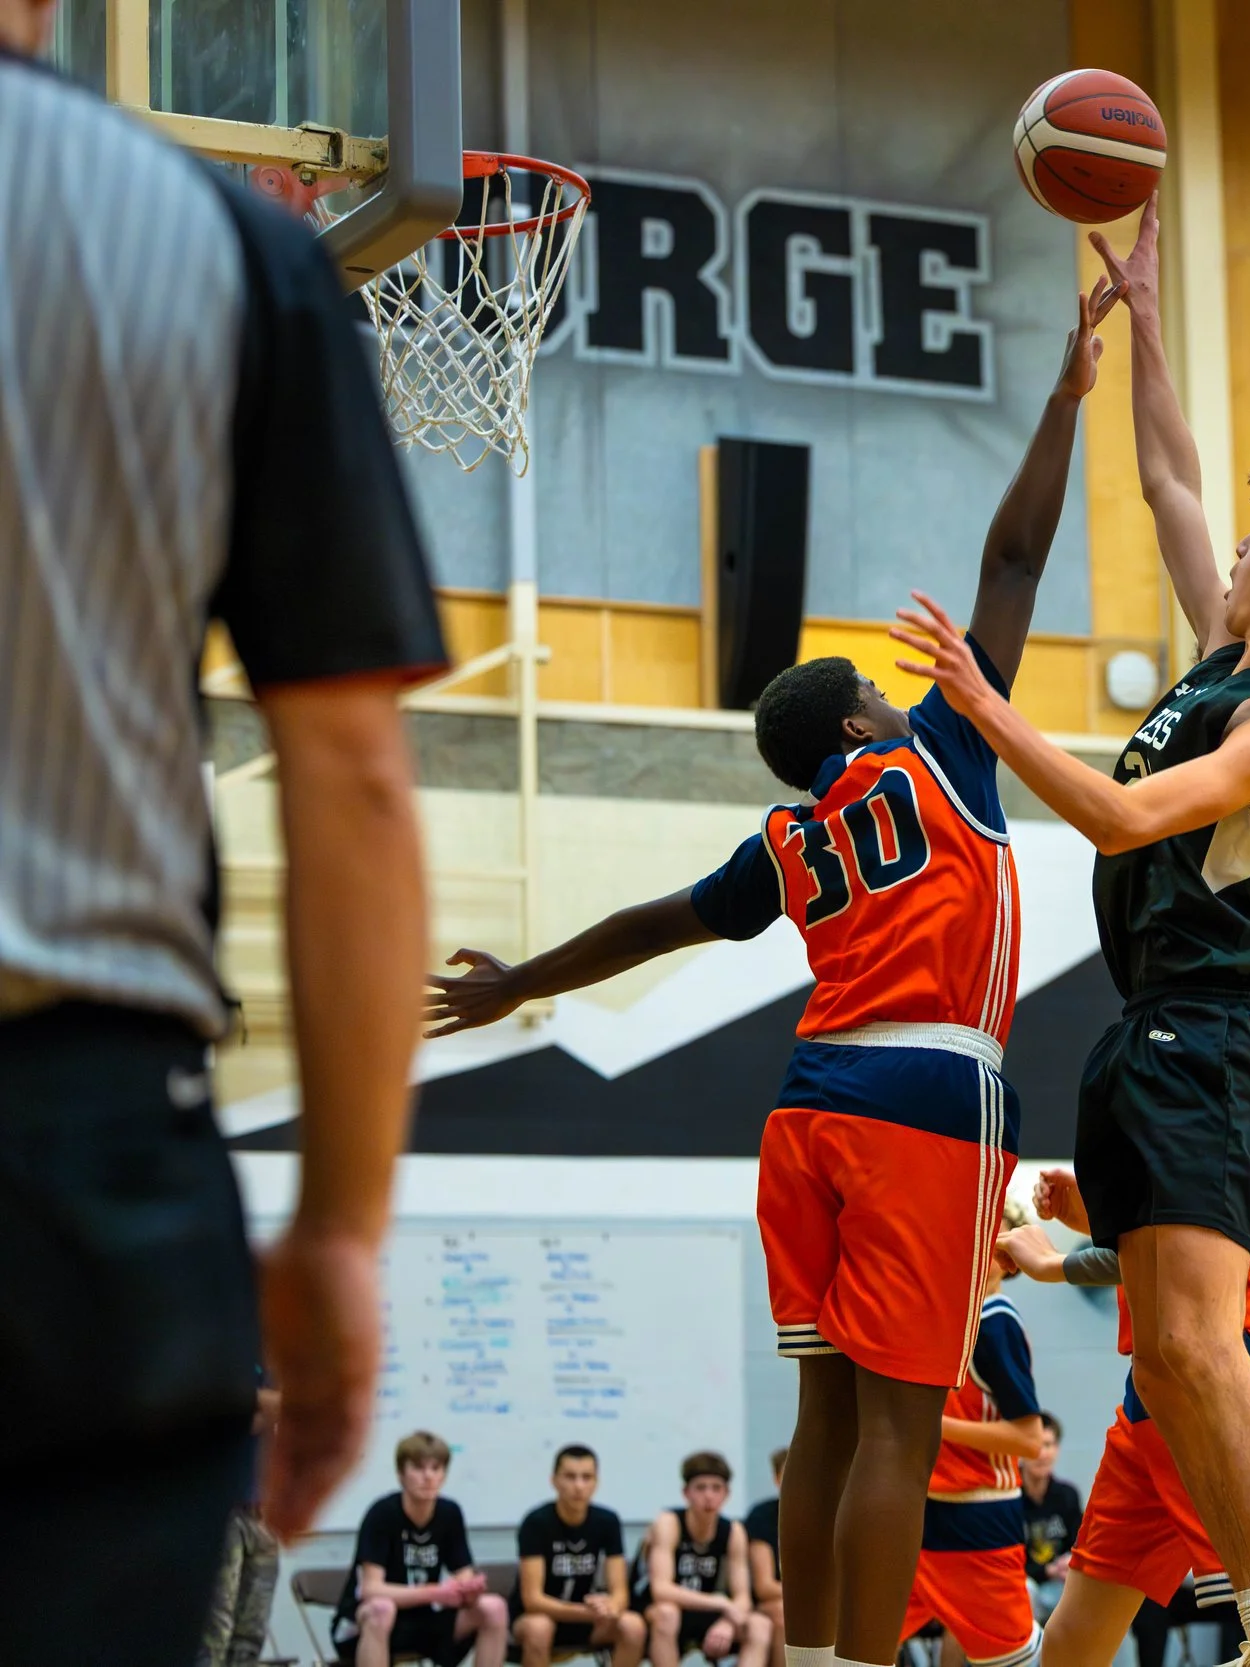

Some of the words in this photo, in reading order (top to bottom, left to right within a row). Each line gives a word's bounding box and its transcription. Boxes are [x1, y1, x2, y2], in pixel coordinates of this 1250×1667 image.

[1101, 106, 1157, 131] molten
[368, 158, 998, 404] ORGE
[1134, 707, 1183, 751] ESS
[781, 766, 932, 931] 30
